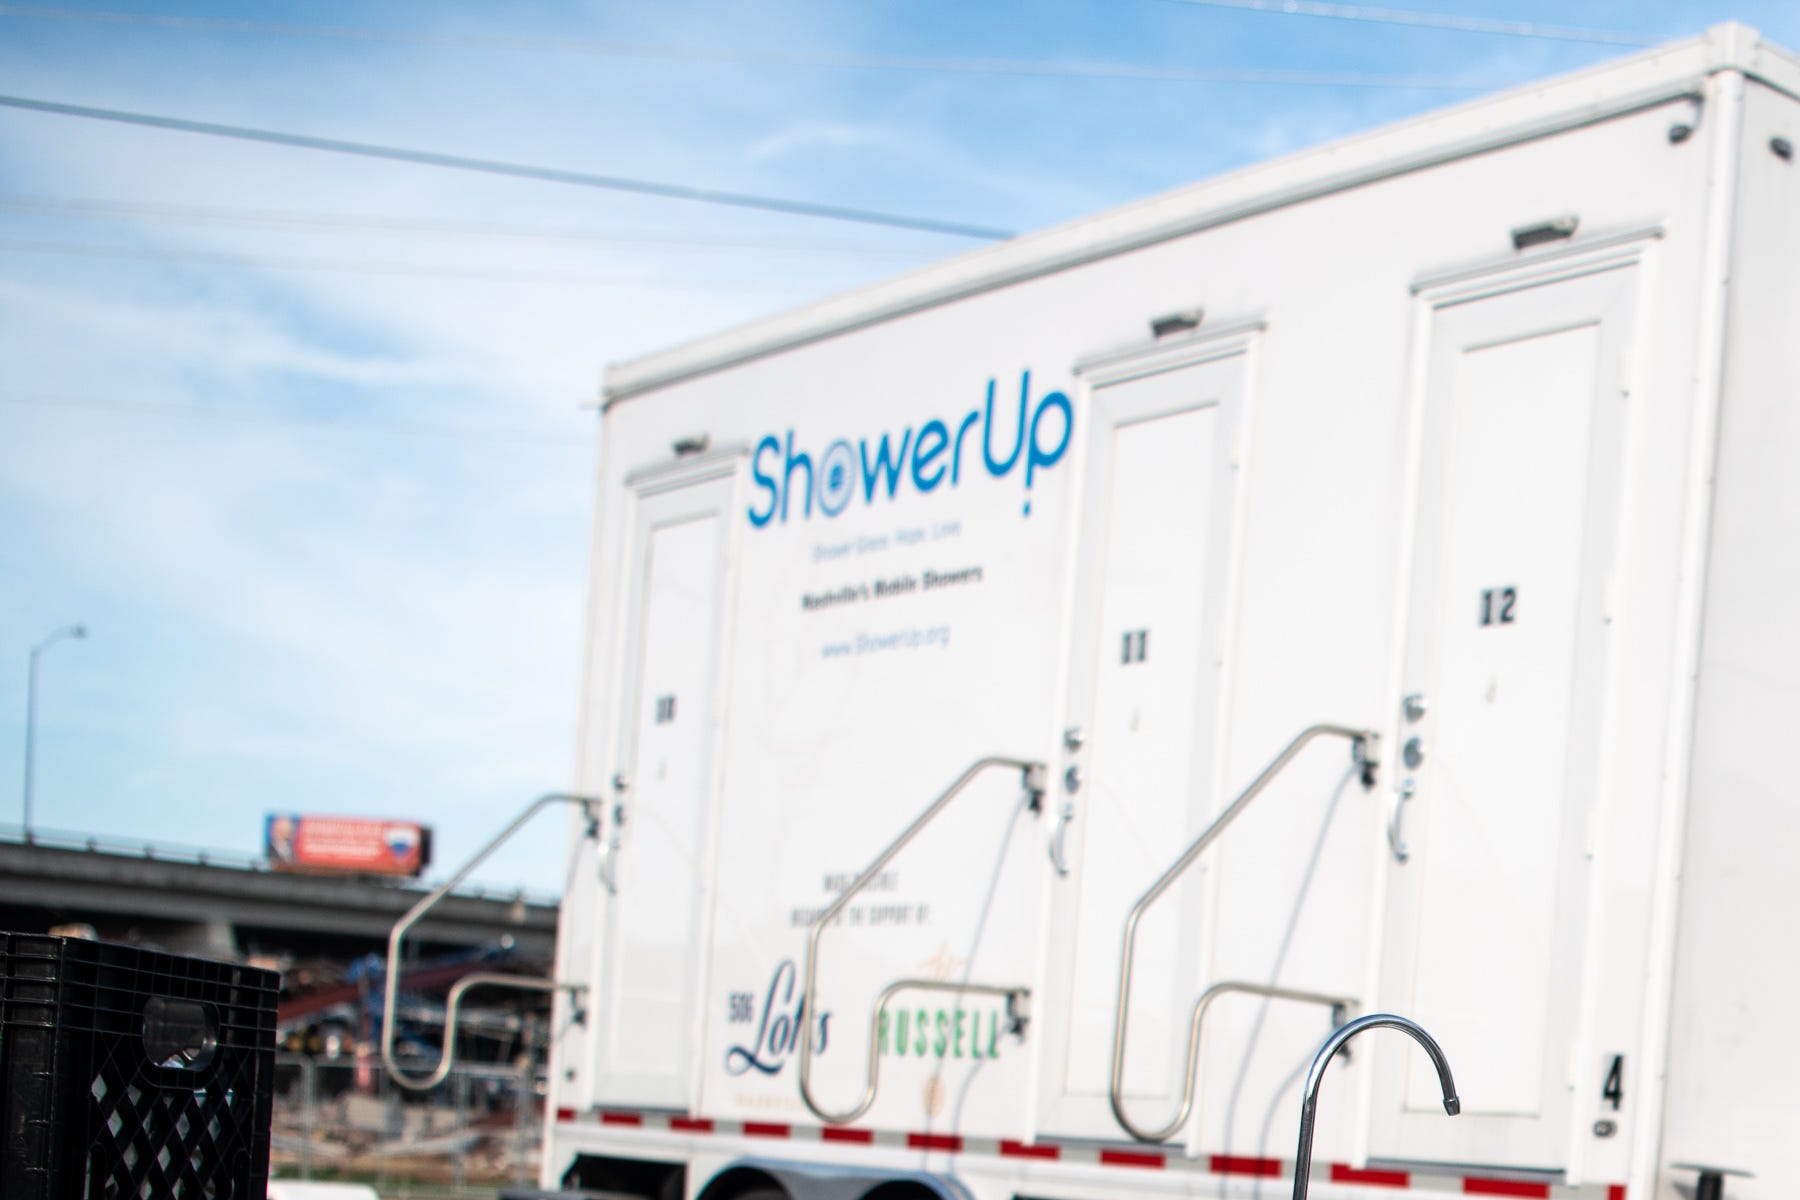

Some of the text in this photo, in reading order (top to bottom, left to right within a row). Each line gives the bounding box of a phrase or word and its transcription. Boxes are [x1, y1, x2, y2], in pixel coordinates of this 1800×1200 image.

[748, 369, 1074, 529] ShowerUp
[922, 566, 984, 590] Showers
[1481, 586, 1516, 625] 12
[1602, 1052, 1623, 1112] 4
